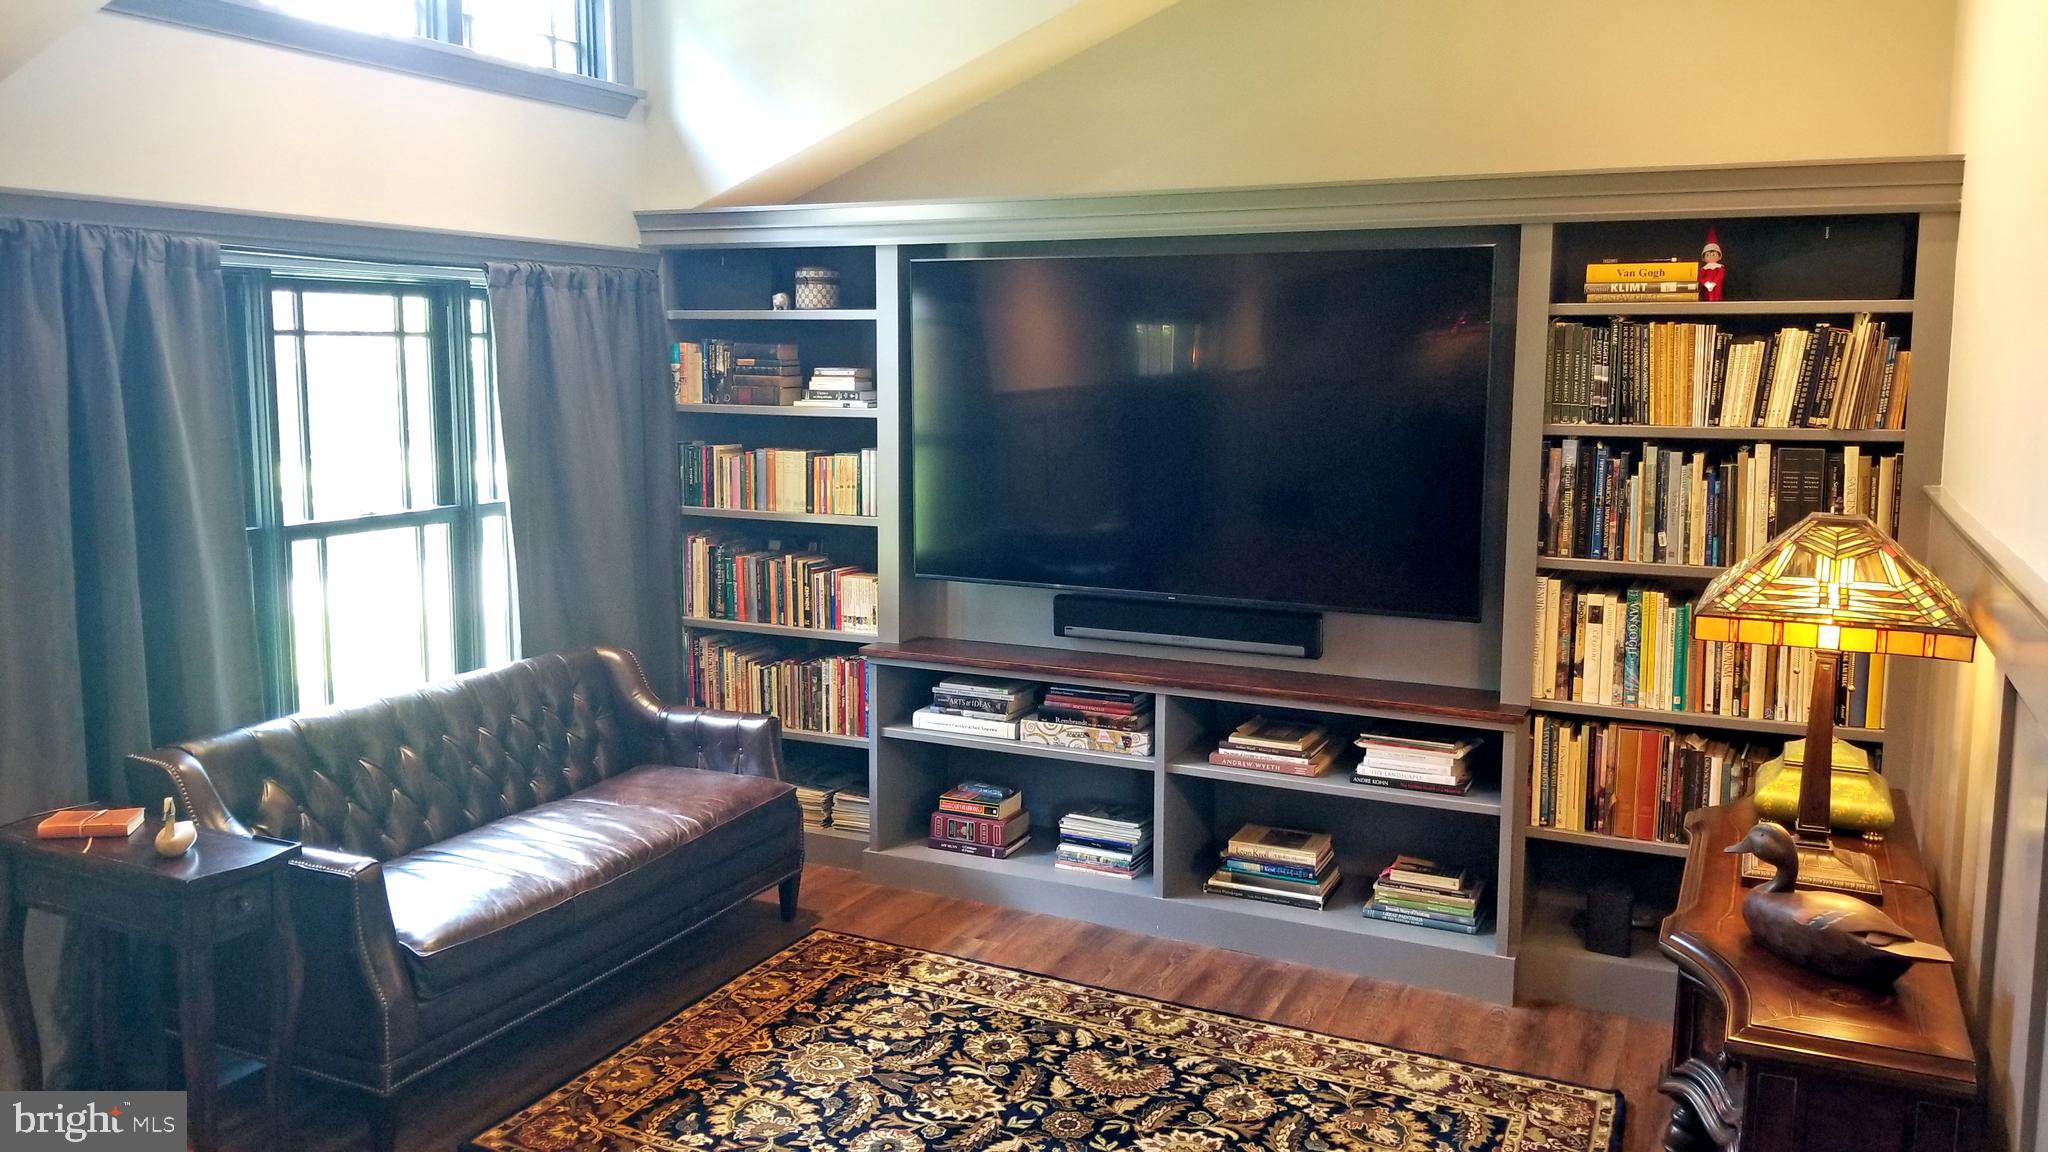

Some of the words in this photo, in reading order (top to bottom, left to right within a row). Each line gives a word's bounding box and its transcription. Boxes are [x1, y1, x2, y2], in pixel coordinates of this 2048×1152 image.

[1617, 269, 1635, 277] Van
[1638, 269, 1665, 279] Gogh
[1610, 283, 1648, 293] KLIMT
[1565, 453, 1575, 489] American
[1847, 476, 1856, 513] SARGEN
[1562, 490, 1573, 542] Impressionism
[1577, 600, 1586, 624] Degas
[1629, 602, 1640, 621] VAN
[1626, 624, 1639, 654] GOGH
[1723, 642, 1734, 678] SIONISM
[971, 700, 991, 708] IDEAS
[1055, 716, 1088, 726] Rembrandt
[1221, 759, 1252, 768] ANDREW
[1255, 763, 1280, 771] WYETH
